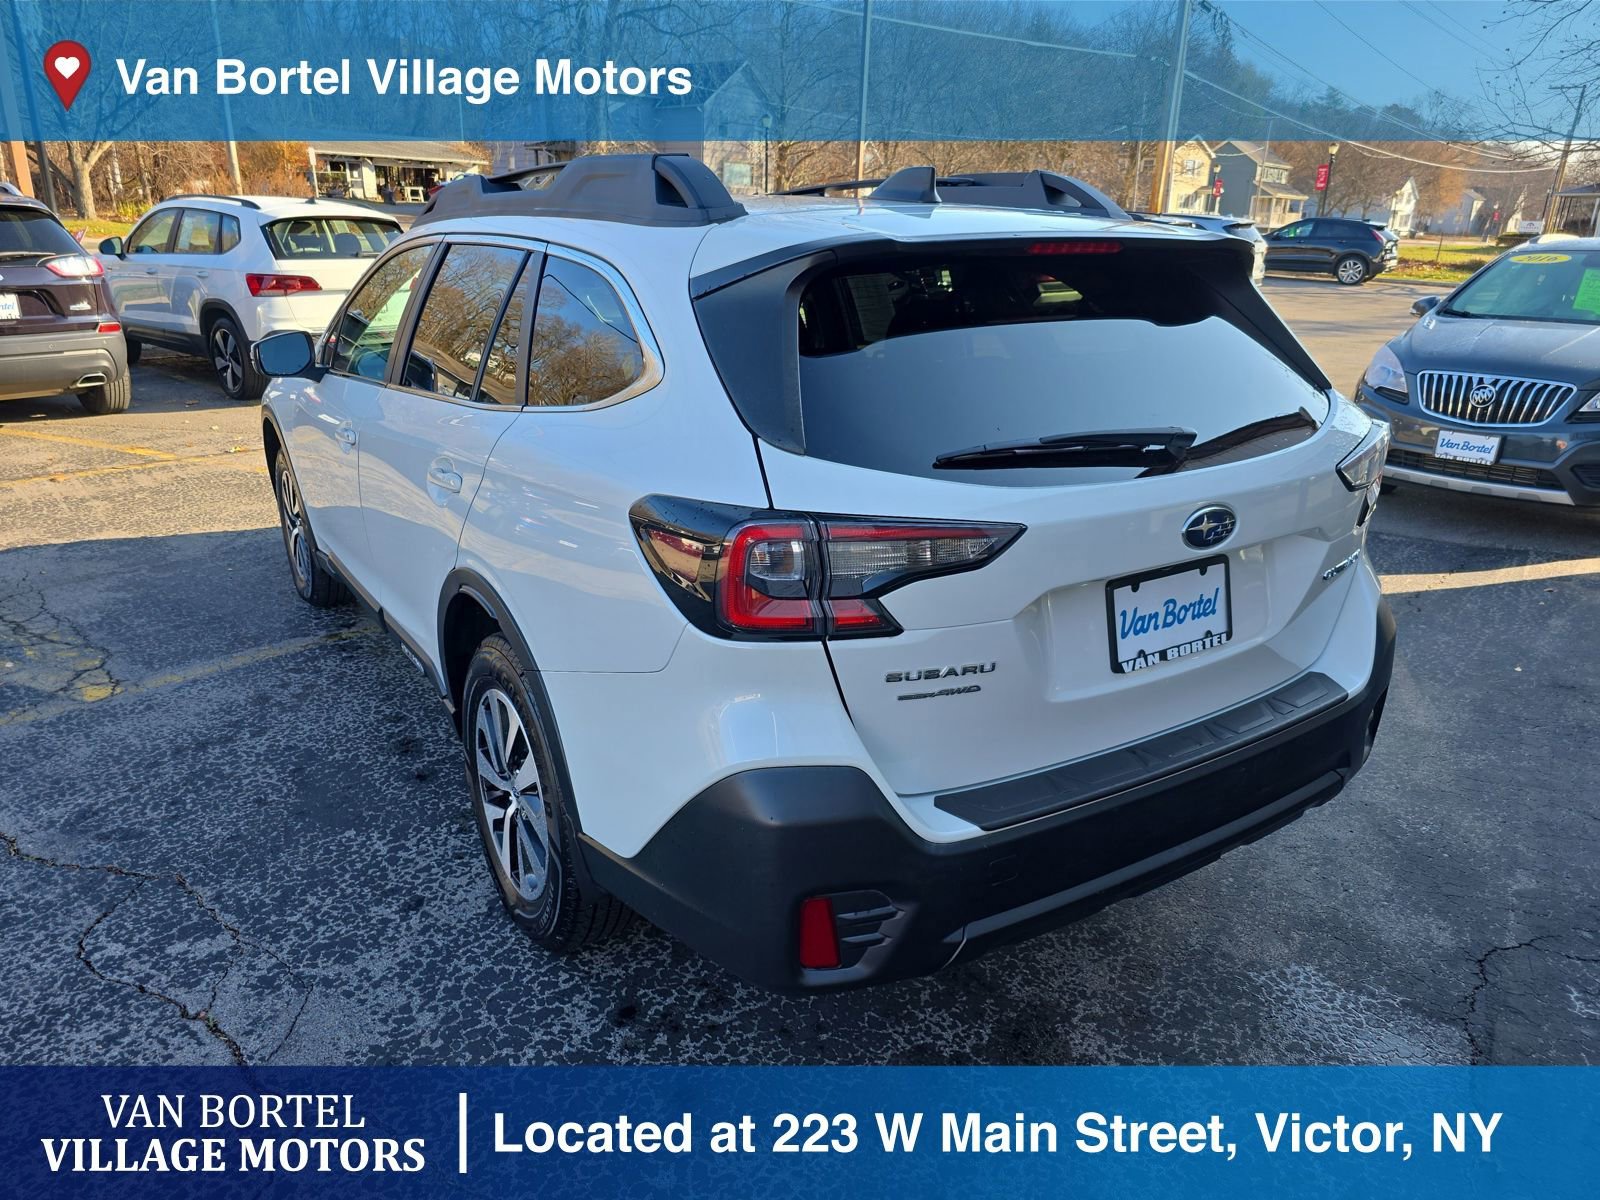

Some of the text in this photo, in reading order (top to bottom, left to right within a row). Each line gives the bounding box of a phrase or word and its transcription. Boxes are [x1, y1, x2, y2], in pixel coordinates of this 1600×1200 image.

[1440, 438, 1495, 454] Van Bortel
[1120, 587, 1220, 640] Van Bortel
[1121, 632, 1230, 673] VAN BORTEL
[885, 662, 997, 683] SUBARU
